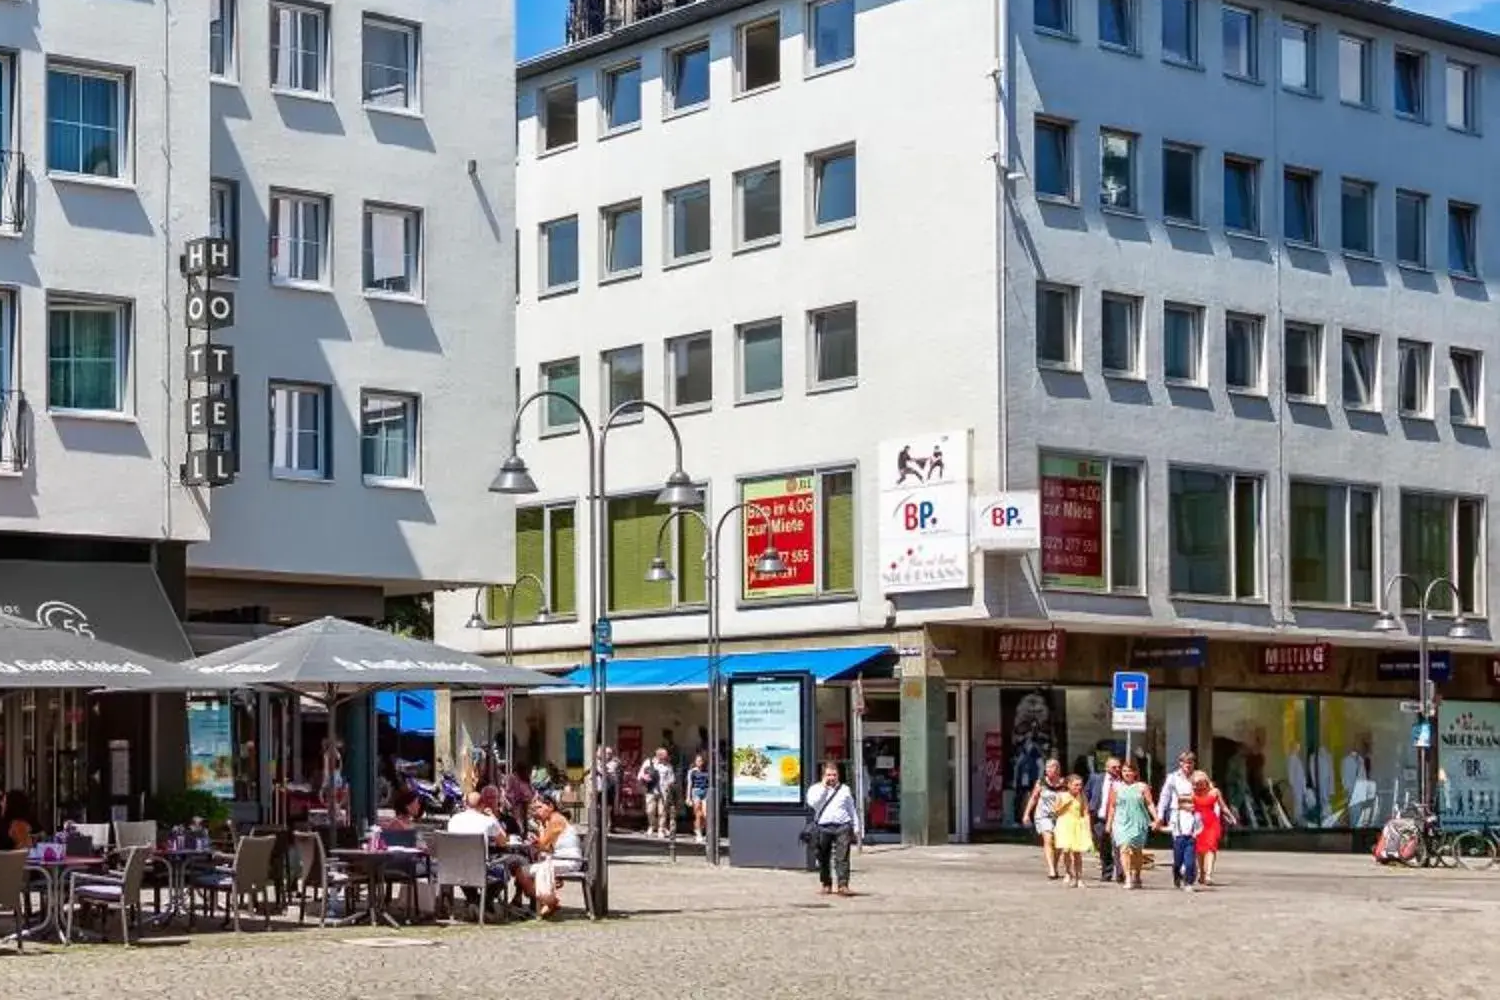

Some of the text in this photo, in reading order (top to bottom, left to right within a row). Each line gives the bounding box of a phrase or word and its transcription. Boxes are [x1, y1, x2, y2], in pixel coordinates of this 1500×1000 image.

[188, 243, 203, 478] HOTEL
[210, 243, 231, 478] HOTEL
[770, 518, 805, 534] Miete
